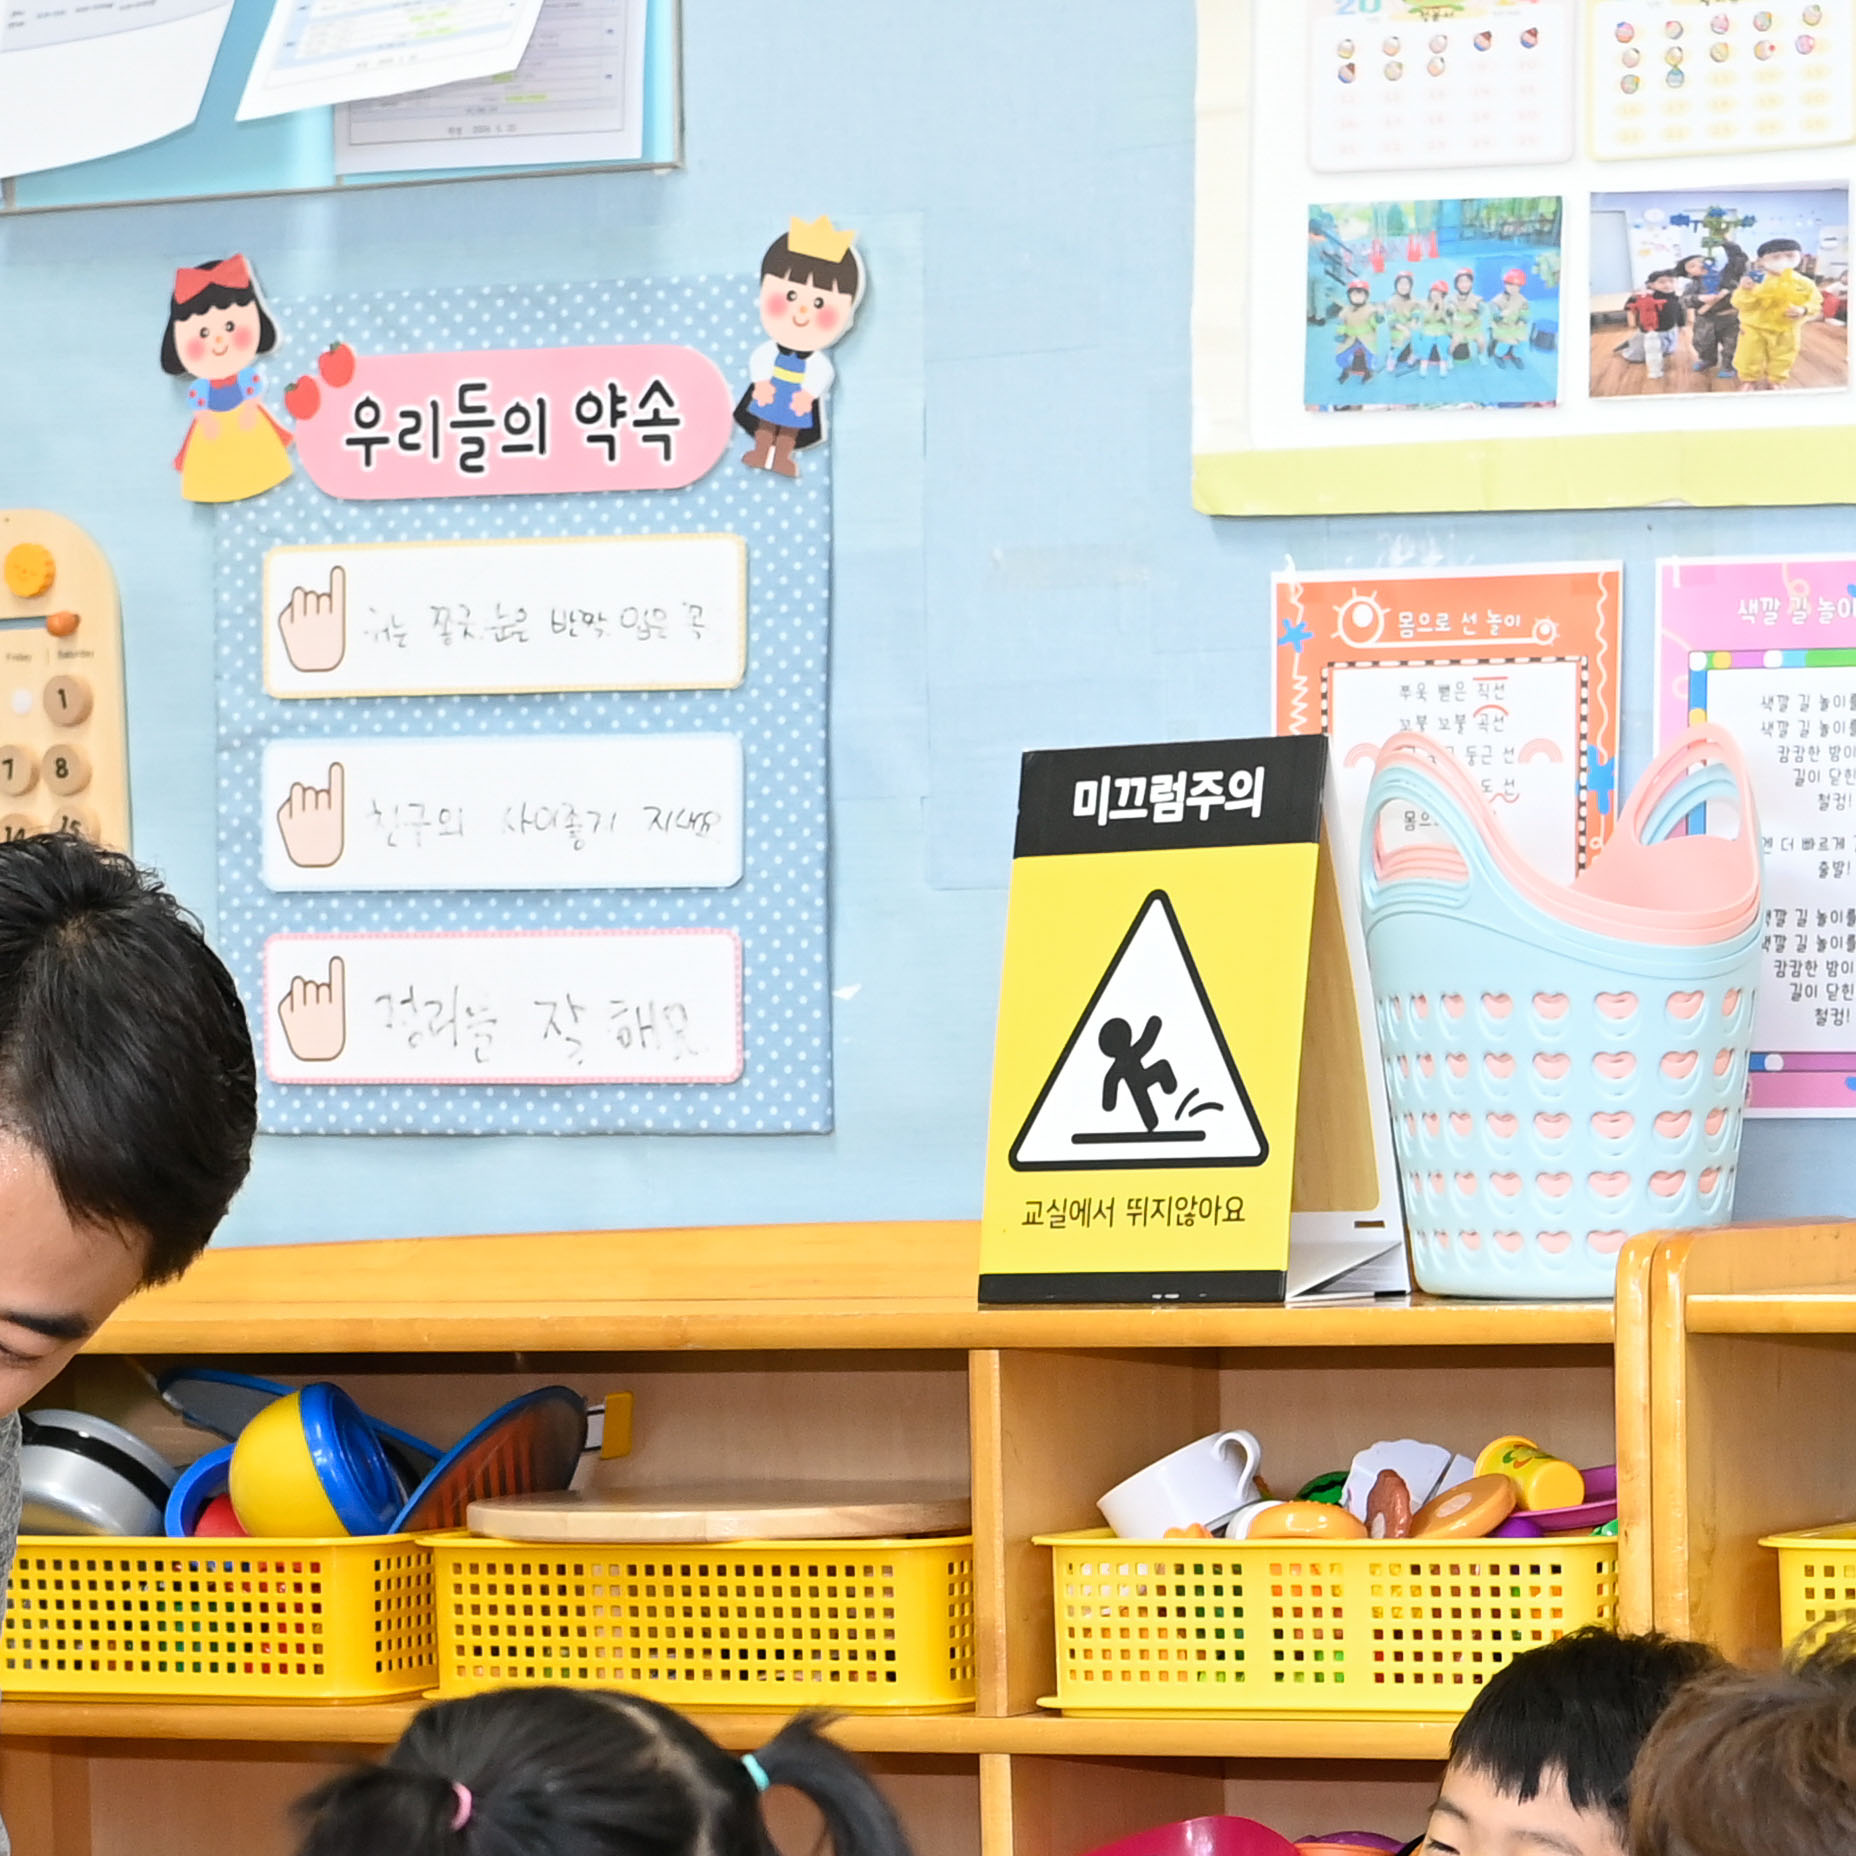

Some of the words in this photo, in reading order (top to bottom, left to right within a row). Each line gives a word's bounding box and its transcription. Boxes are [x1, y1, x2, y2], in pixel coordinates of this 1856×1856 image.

[346, 383, 546, 473] 우리들의
[576, 379, 680, 462] 약속
[1738, 597, 1780, 625] 색깔
[1791, 597, 1808, 625] 길
[1398, 611, 1451, 639] 몸으로
[1461, 612, 1478, 636] 선
[1486, 609, 1521, 636] 놀이
[57, 688, 67, 710] 1
[1478, 683, 1505, 701] 직선
[1760, 694, 1789, 712] 색깔
[1799, 694, 1810, 712] 길
[1478, 713, 1504, 732] 곡선
[1760, 720, 1789, 738] 색깔
[1799, 720, 1810, 738] 길
[1466, 746, 1492, 766] 둥근
[1504, 747, 1514, 764] 선
[1778, 745, 1820, 763] 캄캄한
[1829, 745, 1856, 762] 밤이
[2, 758, 14, 780] 7
[55, 757, 69, 779] 8
[1793, 768, 1820, 787] 길이
[1073, 766, 1265, 826] 미끄럼주의
[1504, 778, 1514, 795] 선
[1819, 793, 1852, 812] 철컹!
[1404, 810, 1439, 831] 몸으
[1781, 837, 1793, 851] 더
[1801, 836, 1845, 851] 빠르게
[1819, 861, 1851, 879] 출발!
[1795, 909, 1808, 928] 길
[1816, 908, 1856, 928] 놀이를
[1795, 935, 1808, 953] 길
[1816, 934, 1856, 953] 놀이를
[1774, 960, 1818, 978] 캄캄한
[1826, 960, 1854, 977] 밤이
[1790, 983, 1817, 1002] 길이
[1815, 1007, 1850, 1026] 철컹!
[1022, 1196, 1115, 1229] 교실에서
[1126, 1194, 1246, 1228] 뛰지않아요
